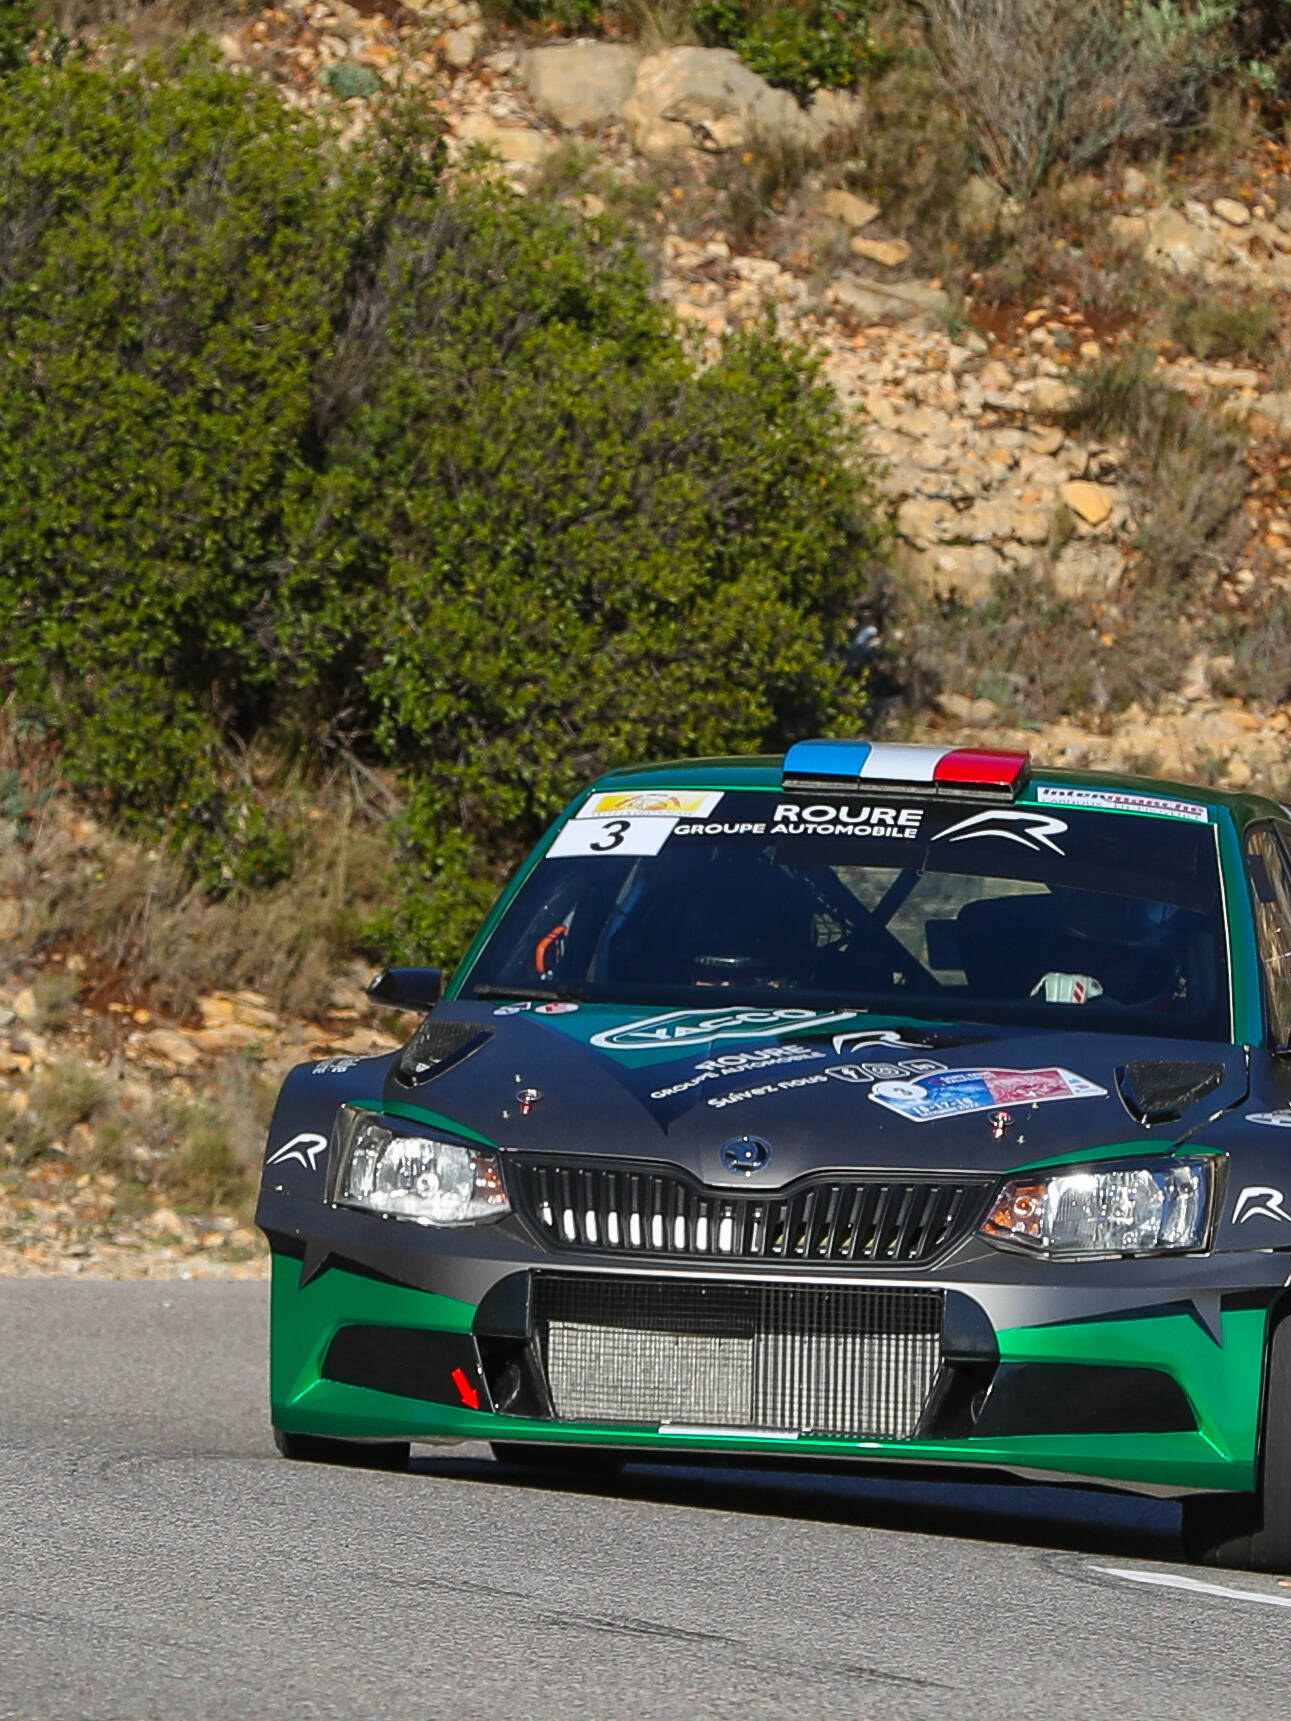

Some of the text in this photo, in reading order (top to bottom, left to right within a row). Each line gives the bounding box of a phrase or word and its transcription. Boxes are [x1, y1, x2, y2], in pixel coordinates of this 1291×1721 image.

[774, 804, 924, 828] ROURE
[589, 820, 631, 852] 3
[674, 822, 918, 840] GROUPE AUTOMOBILE
[694, 1044, 812, 1072] ROURE
[707, 1074, 828, 1108] Suivez nous
